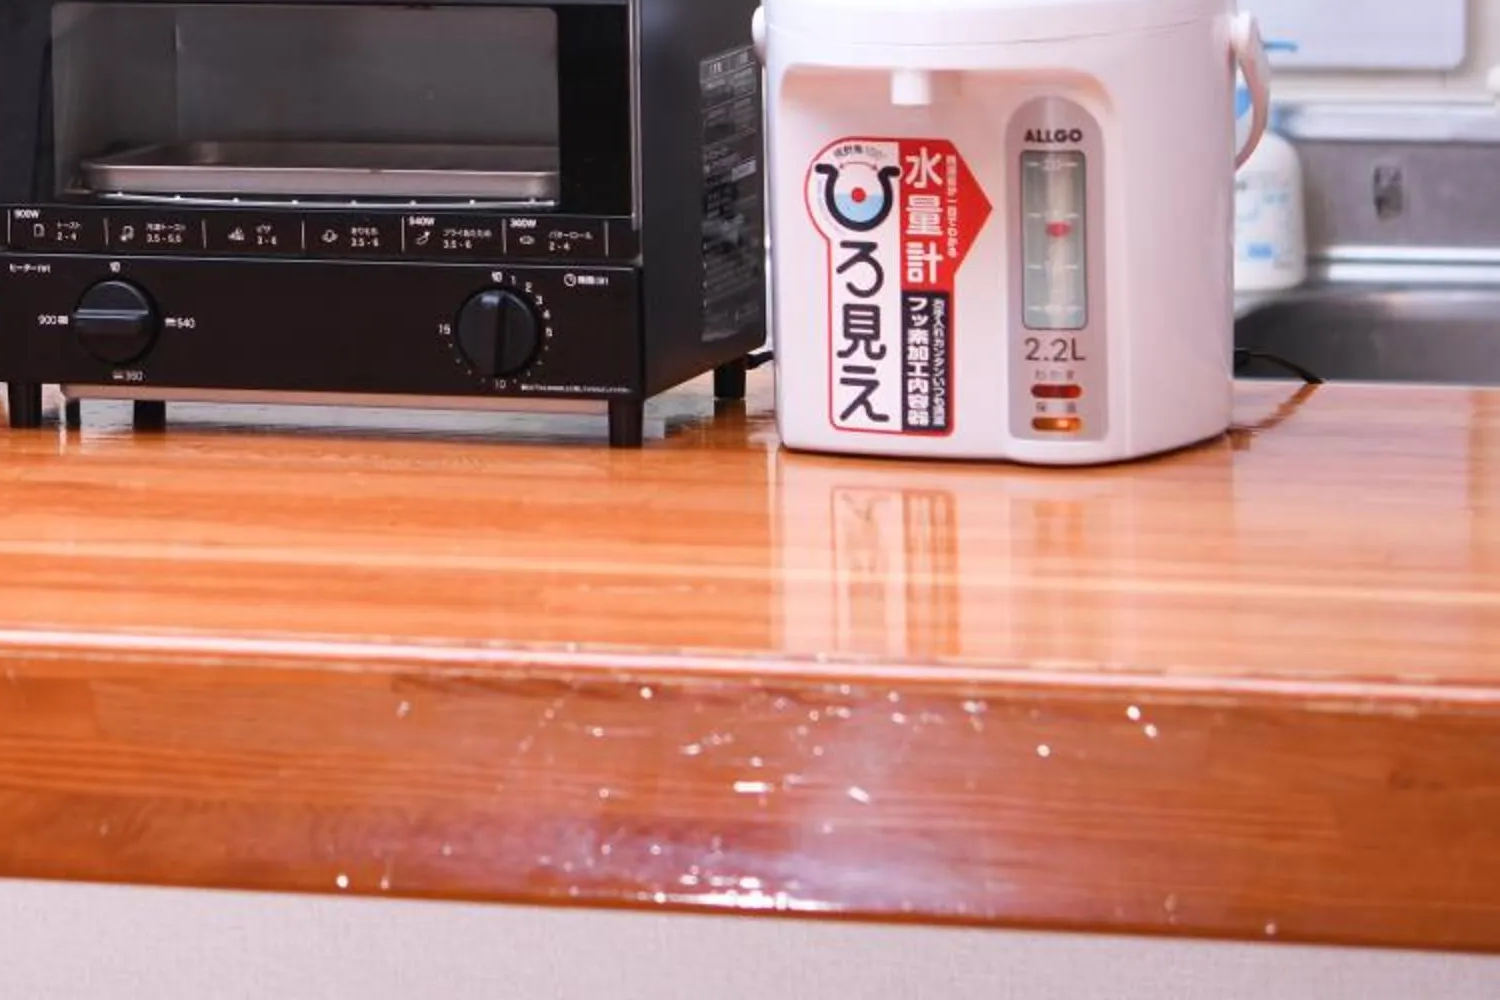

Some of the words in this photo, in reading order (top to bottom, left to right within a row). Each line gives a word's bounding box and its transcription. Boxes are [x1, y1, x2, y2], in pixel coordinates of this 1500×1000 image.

[1024, 129, 1083, 143] ALLGO
[904, 146, 944, 284] 水量計
[511, 275, 517, 286] 1
[525, 281, 533, 293] 2
[536, 295, 544, 305] 3
[543, 309, 551, 320] 4
[1024, 337, 1086, 362] 2.2L
[494, 379, 506, 390] 10
